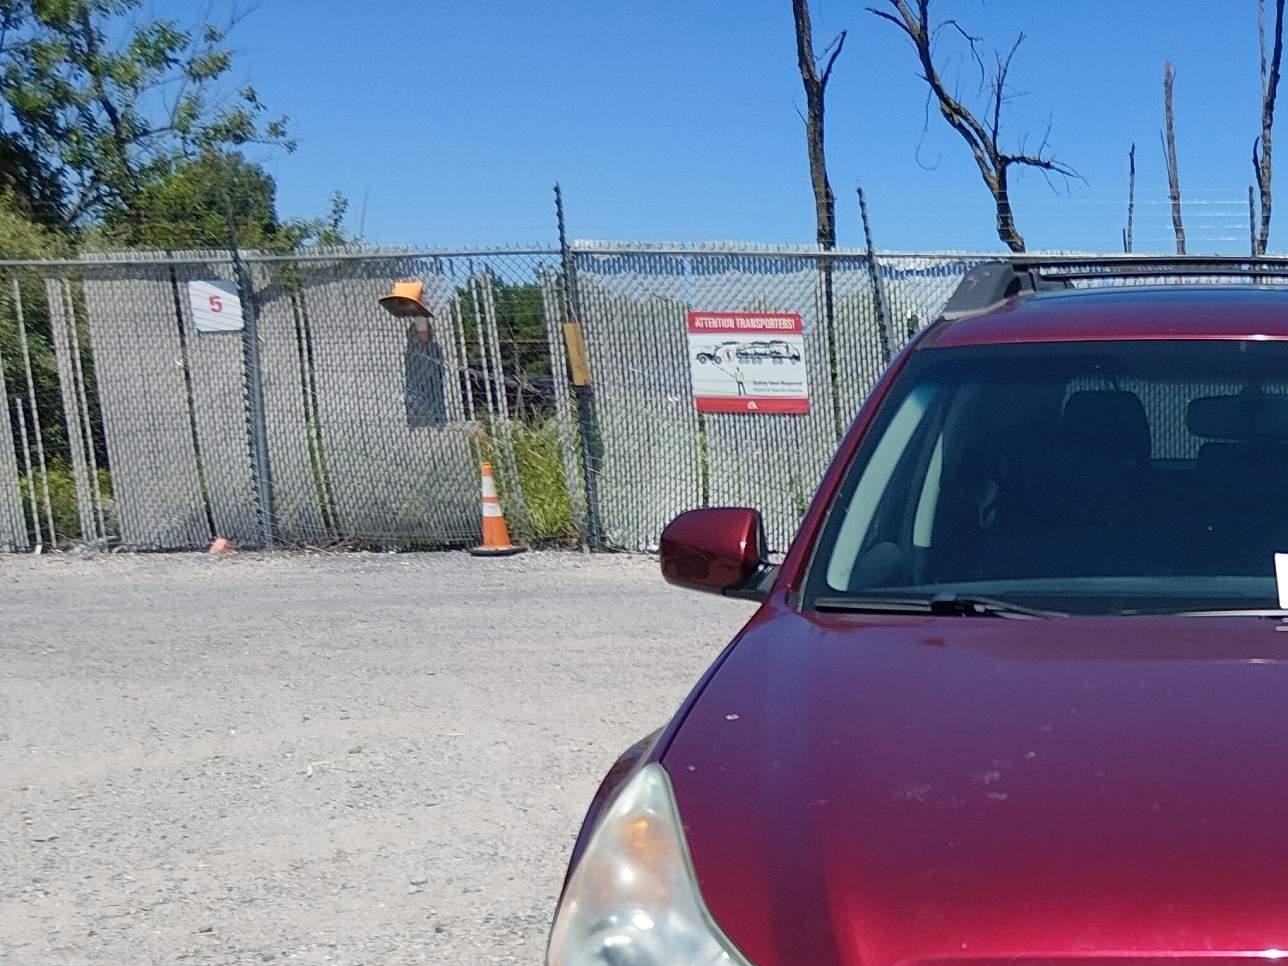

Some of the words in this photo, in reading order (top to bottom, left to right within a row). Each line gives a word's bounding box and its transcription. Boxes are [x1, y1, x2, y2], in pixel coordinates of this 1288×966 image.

[208, 295, 223, 313] 5
[695, 317, 734, 329] ATTENTION
[735, 317, 796, 330] TRANSPORTERS!
